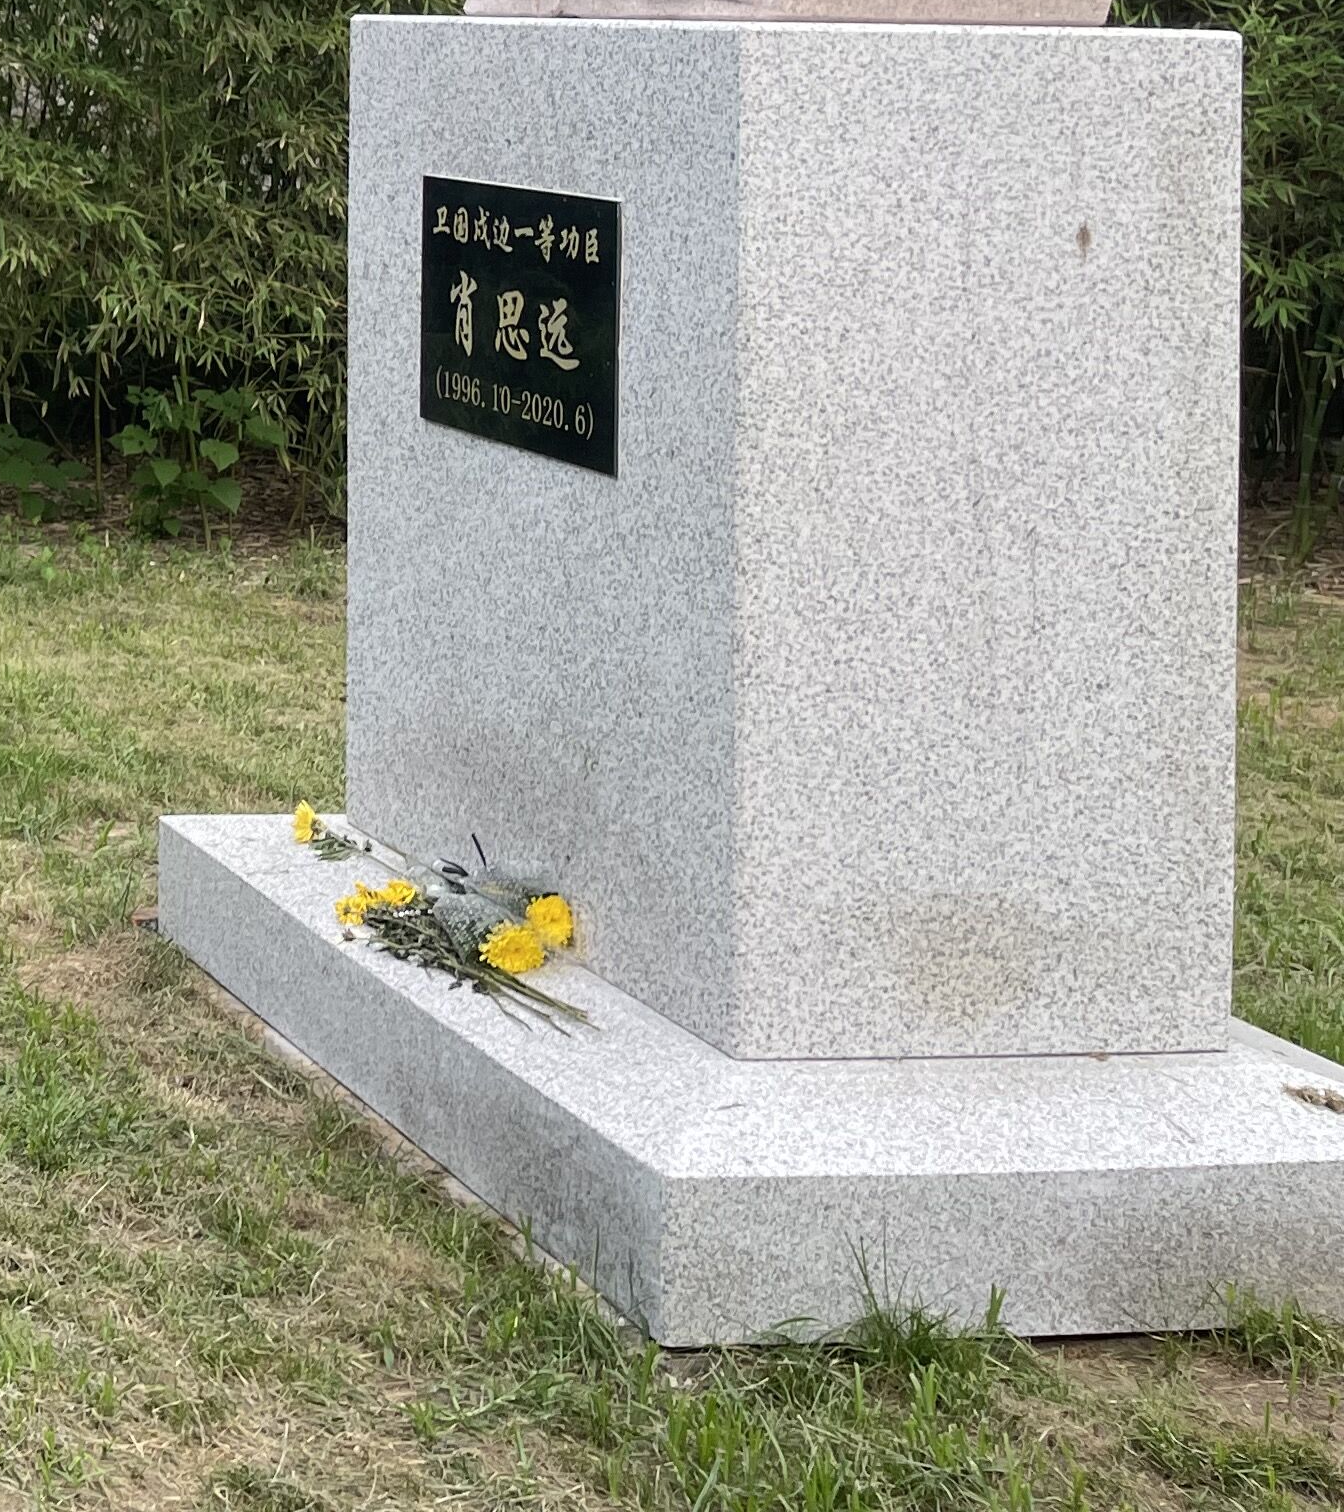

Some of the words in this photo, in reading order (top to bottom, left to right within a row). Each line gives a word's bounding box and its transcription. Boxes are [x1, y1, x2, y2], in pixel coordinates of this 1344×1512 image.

[432, 204, 600, 264] 卫国戍边一等功臣
[450, 269, 580, 371] 肖思远
[436, 365, 594, 440] (1996.10-2020.6)
